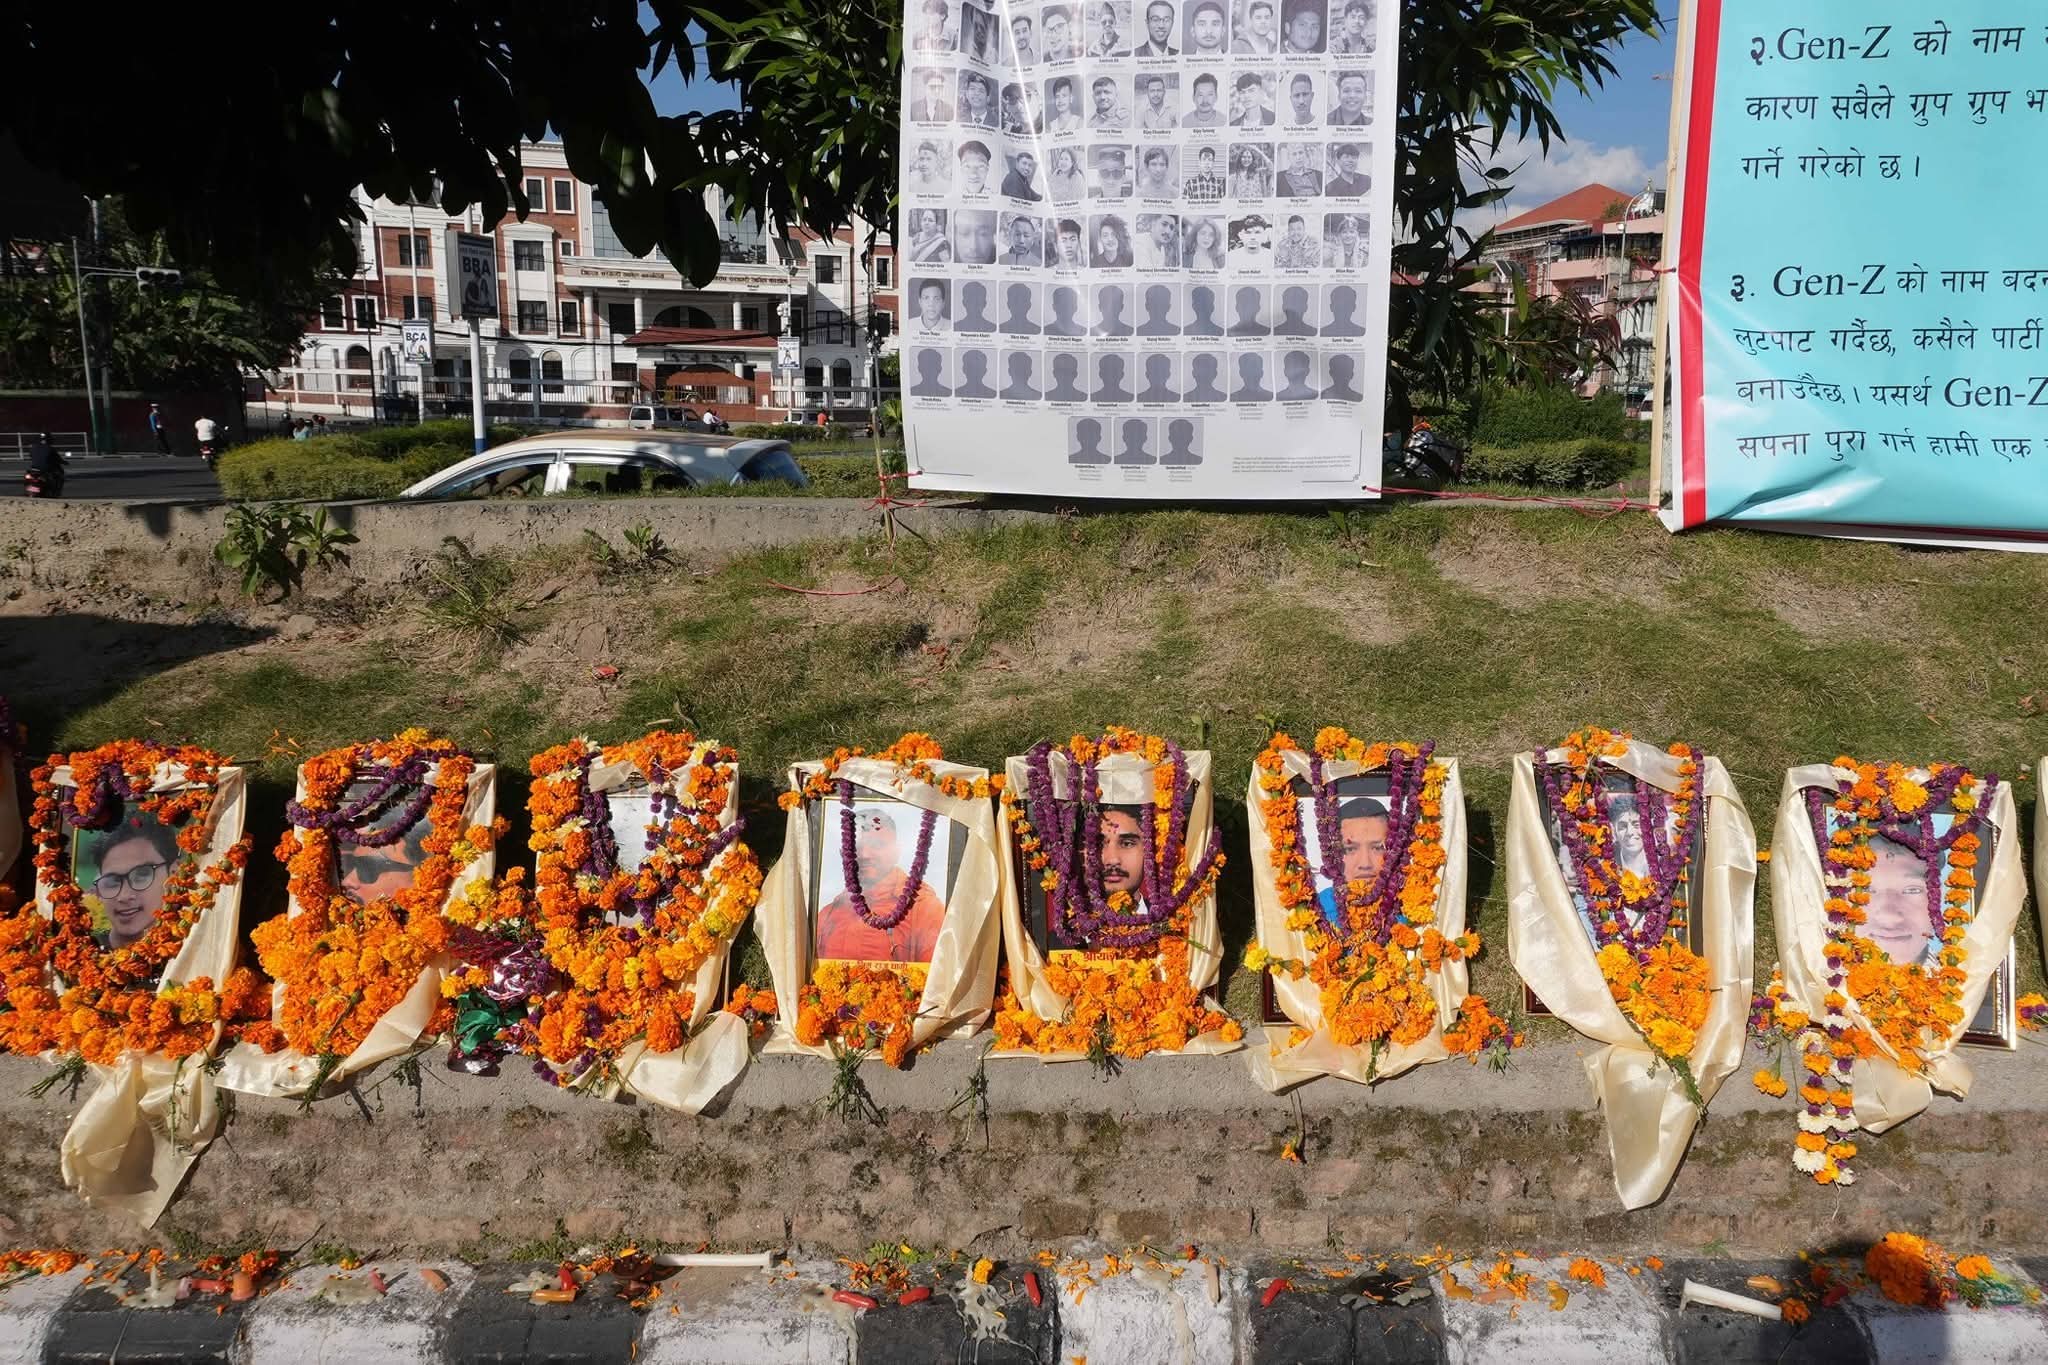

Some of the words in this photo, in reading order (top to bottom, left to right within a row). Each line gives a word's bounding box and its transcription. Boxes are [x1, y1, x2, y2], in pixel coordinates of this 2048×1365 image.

[1913, 20, 1951, 56] को
[1972, 28, 2025, 53] नाम
[1745, 97, 1819, 120] कारण
[1831, 84, 1895, 120] सबैले
[1909, 93, 1953, 126] ग्रुप
[1968, 91, 2011, 124] ग्रुप
[2026, 90, 2048, 112] भ
[1741, 147, 1784, 179] गर्ने
[1798, 147, 1865, 178] गरेको
[1879, 156, 1901, 180] छ
[462, 256, 490, 274] BBA
[1774, 265, 1886, 296] Gen-Z
[1896, 263, 1928, 293] को
[1940, 271, 1989, 293] नाम
[406, 332, 427, 342] BCA
[1733, 329, 1815, 355] लुटपाट
[1912, 317, 1978, 350] कसैले
[1992, 318, 2044, 349] पार्टी
[1869, 376, 1932, 406] यसर्थ
[1944, 377, 2048, 407] Gen-Z
[1736, 433, 1810, 457] सपना
[1825, 431, 1866, 461] पुरा
[1879, 428, 1915, 452] गर्न
[1927, 431, 1979, 456] हामी
[1991, 439, 2031, 462] एक
